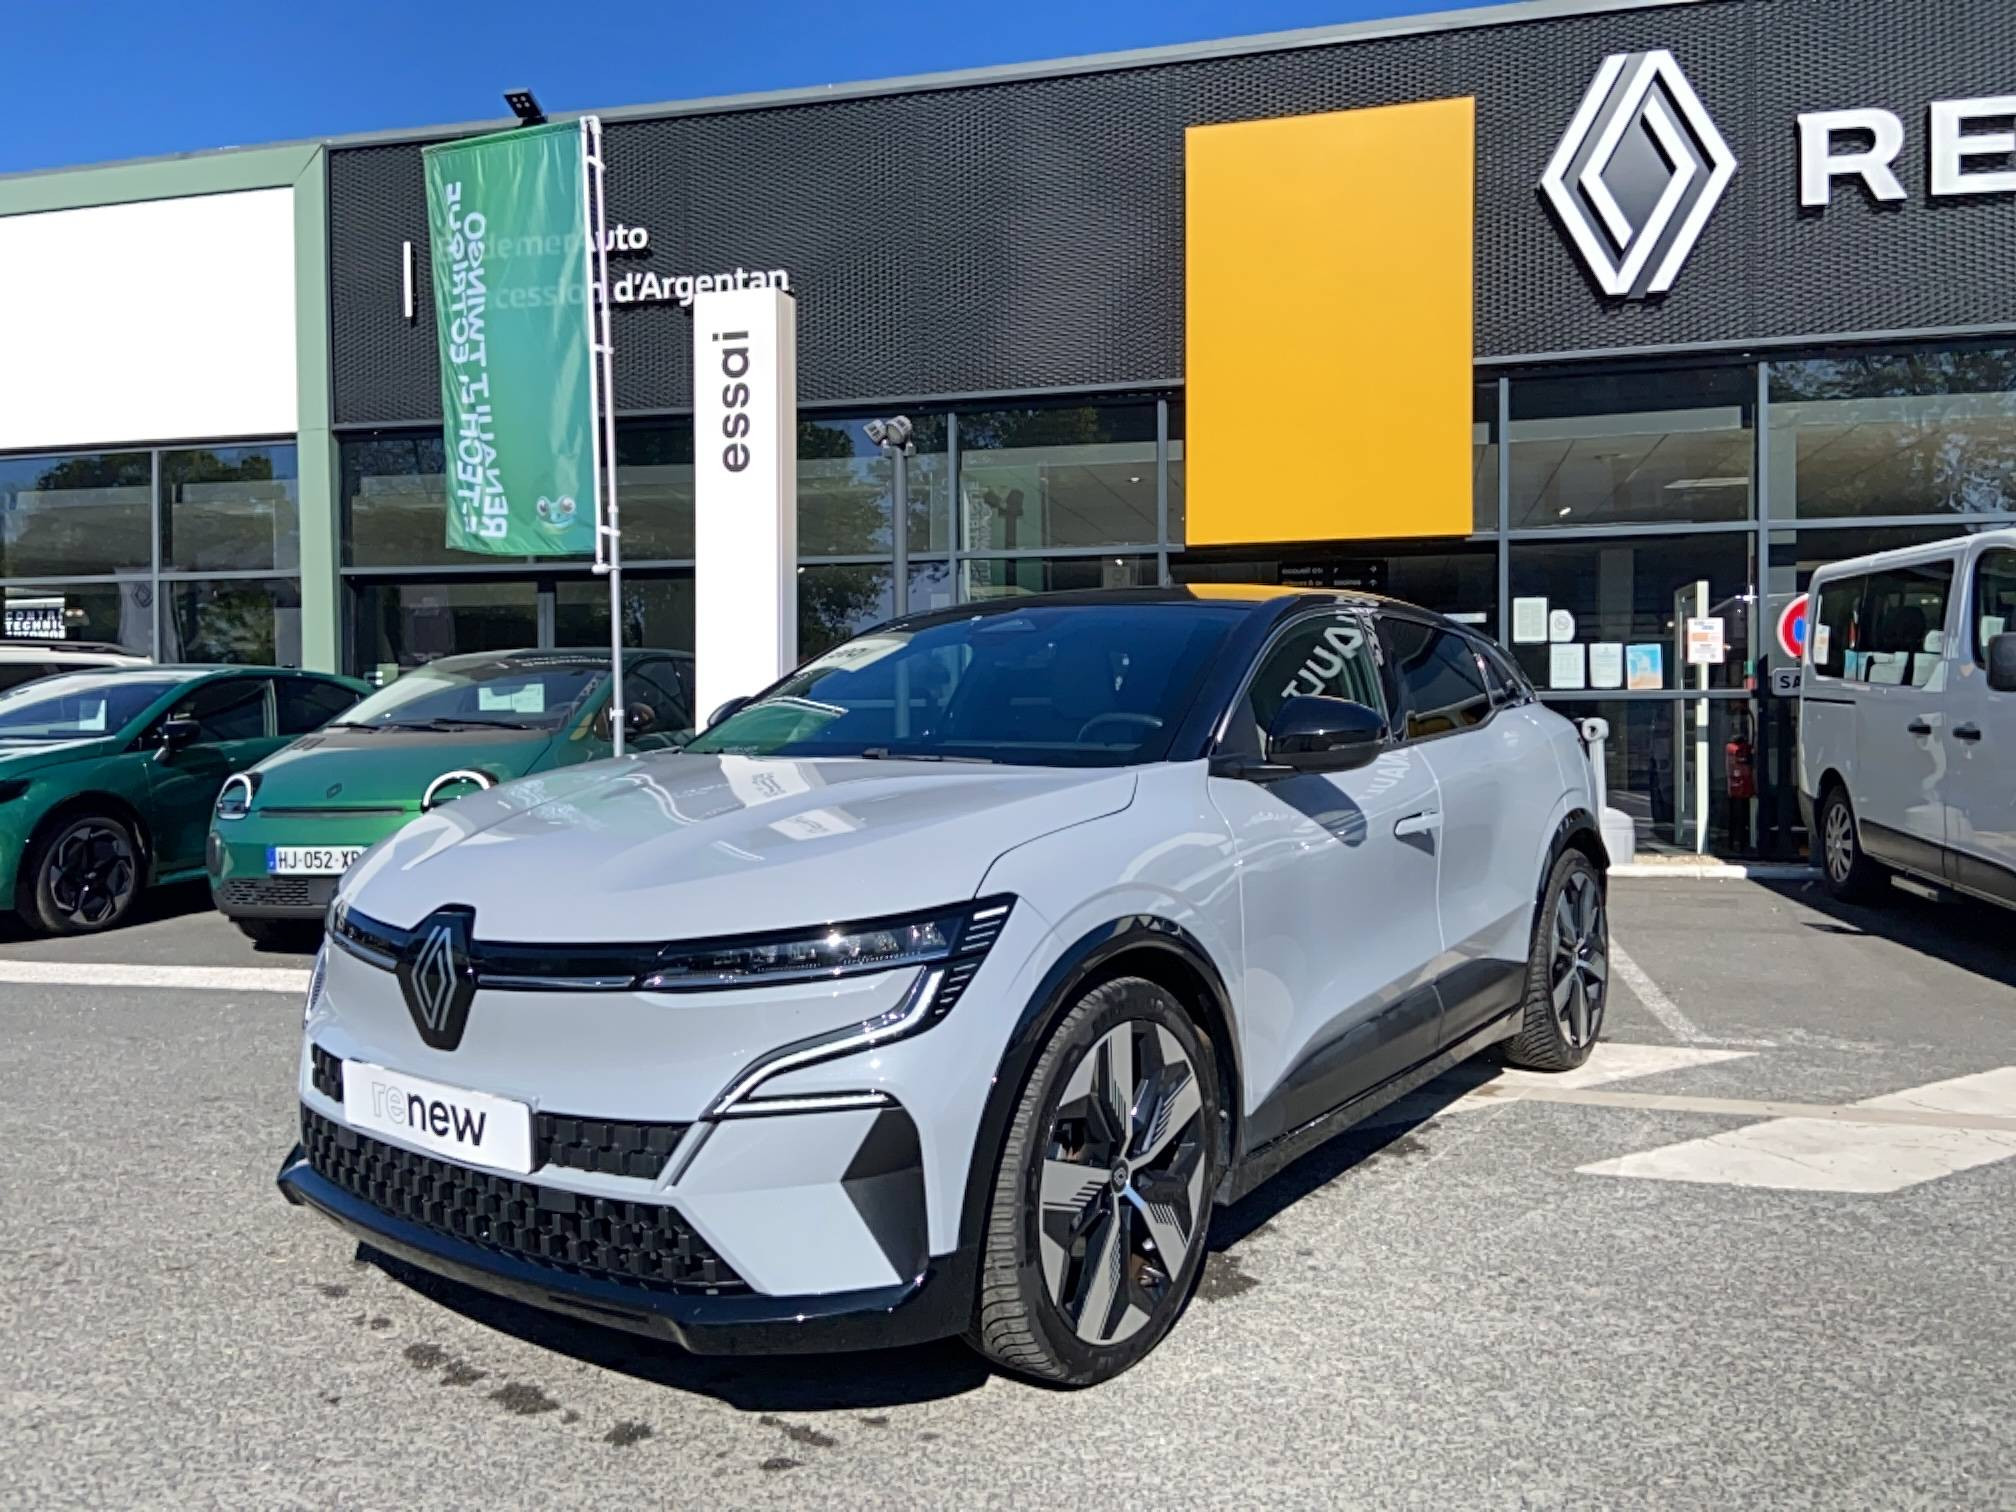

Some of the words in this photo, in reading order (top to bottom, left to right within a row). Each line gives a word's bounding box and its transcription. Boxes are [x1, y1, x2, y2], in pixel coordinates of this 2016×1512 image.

[1797, 96, 2016, 207] RE
[613, 266, 789, 306] d'Argentan
[712, 330, 750, 473] essai
[371, 1080, 487, 1147] renew
